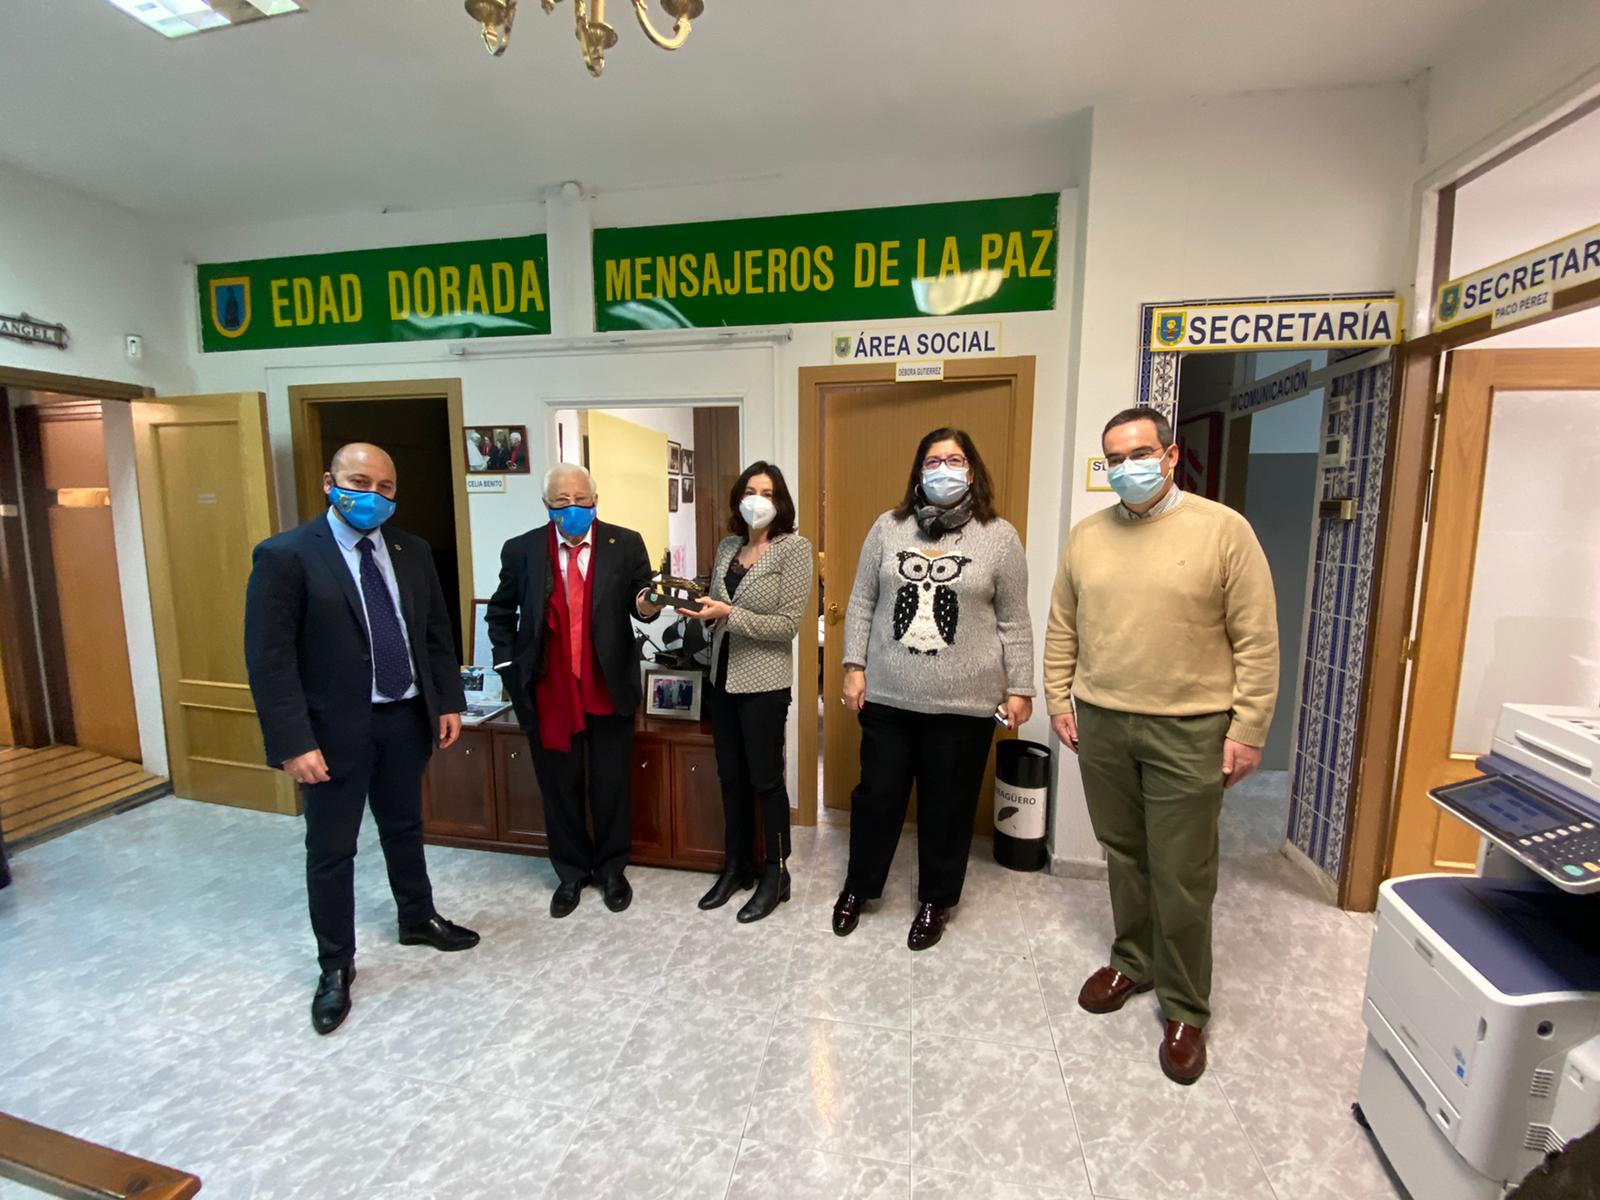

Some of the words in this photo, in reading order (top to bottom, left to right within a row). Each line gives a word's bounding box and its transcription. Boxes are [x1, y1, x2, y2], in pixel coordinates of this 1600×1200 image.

[605, 245, 834, 302] MENSAJEROS
[854, 240, 900, 288] DE
[917, 236, 961, 284] LA
[981, 229, 1053, 280] PAZ
[1463, 239, 1600, 309] SECRETAR
[271, 273, 363, 327] EDAD
[388, 260, 545, 321] DORADA
[1495, 302, 1518, 318] PACO
[1519, 292, 1549, 310] PÉREZ
[854, 331, 911, 358] ÁREA
[917, 331, 996, 355] SOCIAL
[1188, 302, 1392, 346] SECRETARÍA
